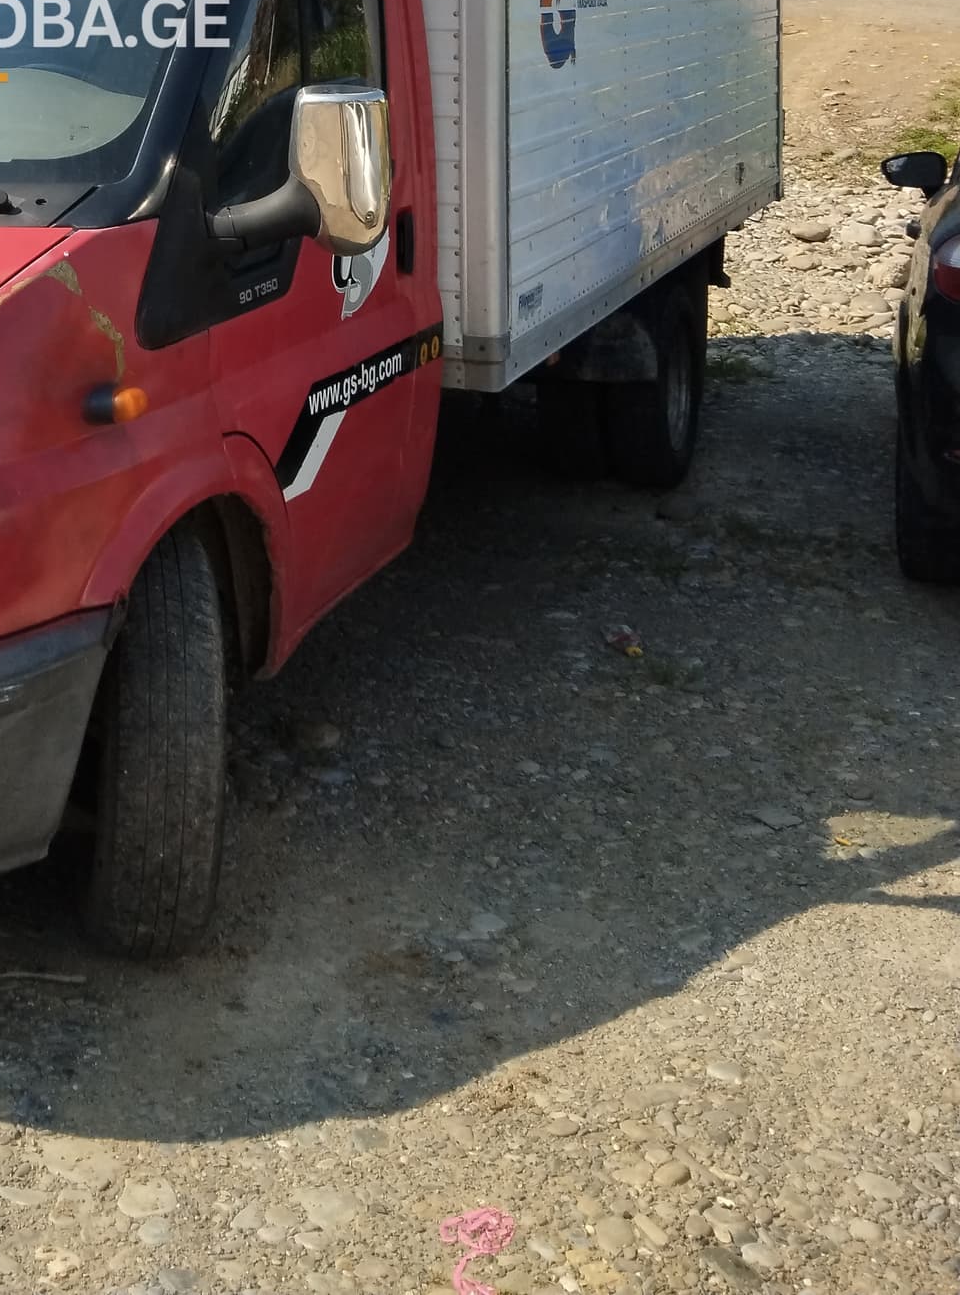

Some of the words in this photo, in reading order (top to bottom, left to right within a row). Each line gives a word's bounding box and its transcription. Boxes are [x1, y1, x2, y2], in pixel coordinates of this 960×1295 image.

[239, 288, 253, 304] 90
[254, 277, 279, 298] T350
[308, 352, 403, 415] www.gs-bg.com
